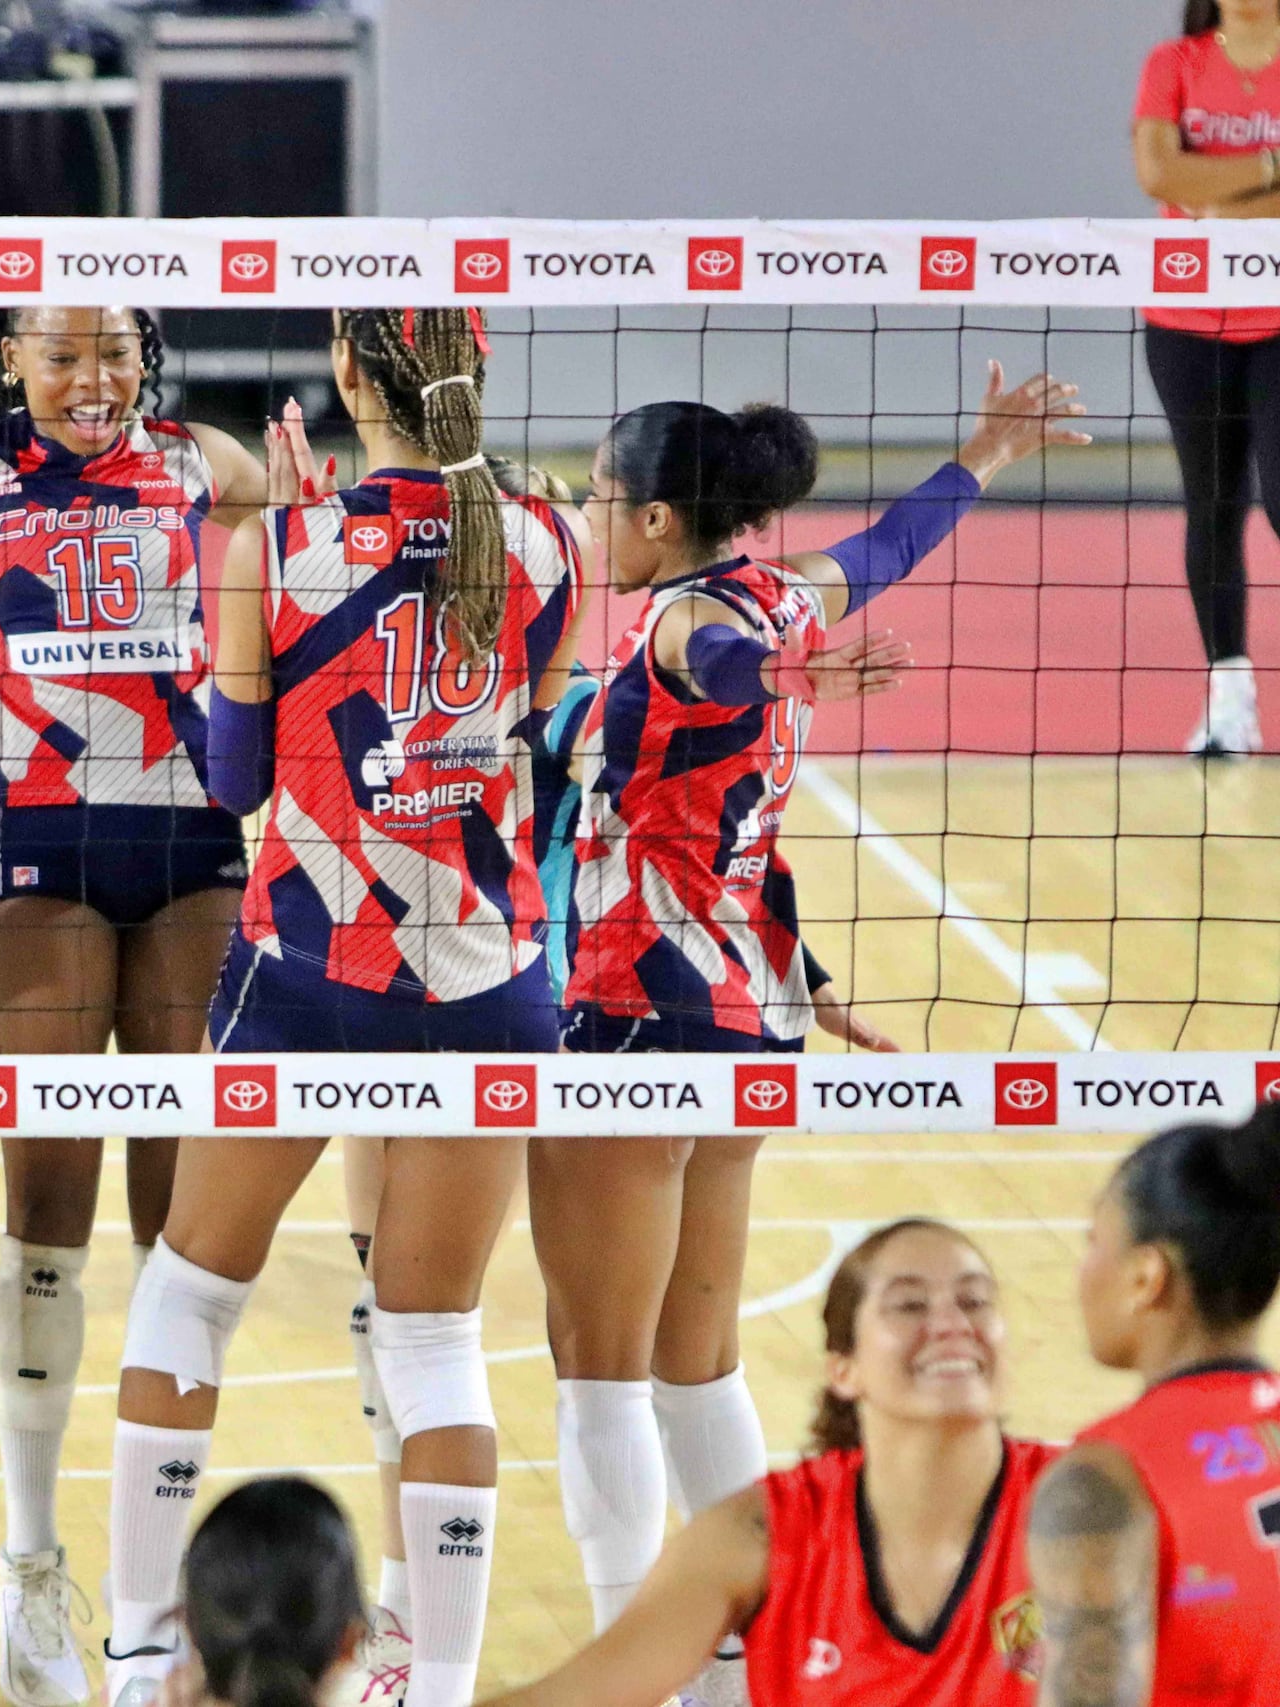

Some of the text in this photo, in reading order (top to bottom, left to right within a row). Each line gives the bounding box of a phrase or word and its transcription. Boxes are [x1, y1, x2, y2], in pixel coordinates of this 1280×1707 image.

[58, 254, 187, 277] TOYOTA
[291, 255, 421, 278] TOYOTA
[524, 253, 654, 276] TOYOTA
[757, 252, 887, 275] TOYOTA
[990, 253, 1120, 276] TOYOTA
[1222, 254, 1280, 277] TOY
[132, 479, 181, 490] TOYOTA
[402, 517, 453, 542] TOY
[401, 546, 450, 560] Financ
[46, 535, 144, 628] 15
[21, 639, 183, 666] UNIVERSAL
[375, 591, 499, 723] 18
[404, 735, 499, 757] COOPERATIVA
[432, 756, 498, 771] ORIENTAL
[372, 781, 485, 817] PREMIER
[32, 1082, 182, 1110] TOYOTA
[293, 1082, 442, 1109] TOYOTA
[553, 1082, 702, 1109] TOYOTA
[812, 1081, 962, 1109] TOYOTA
[1073, 1080, 1223, 1107] TOYOTA
[1189, 1423, 1268, 1481] 25
